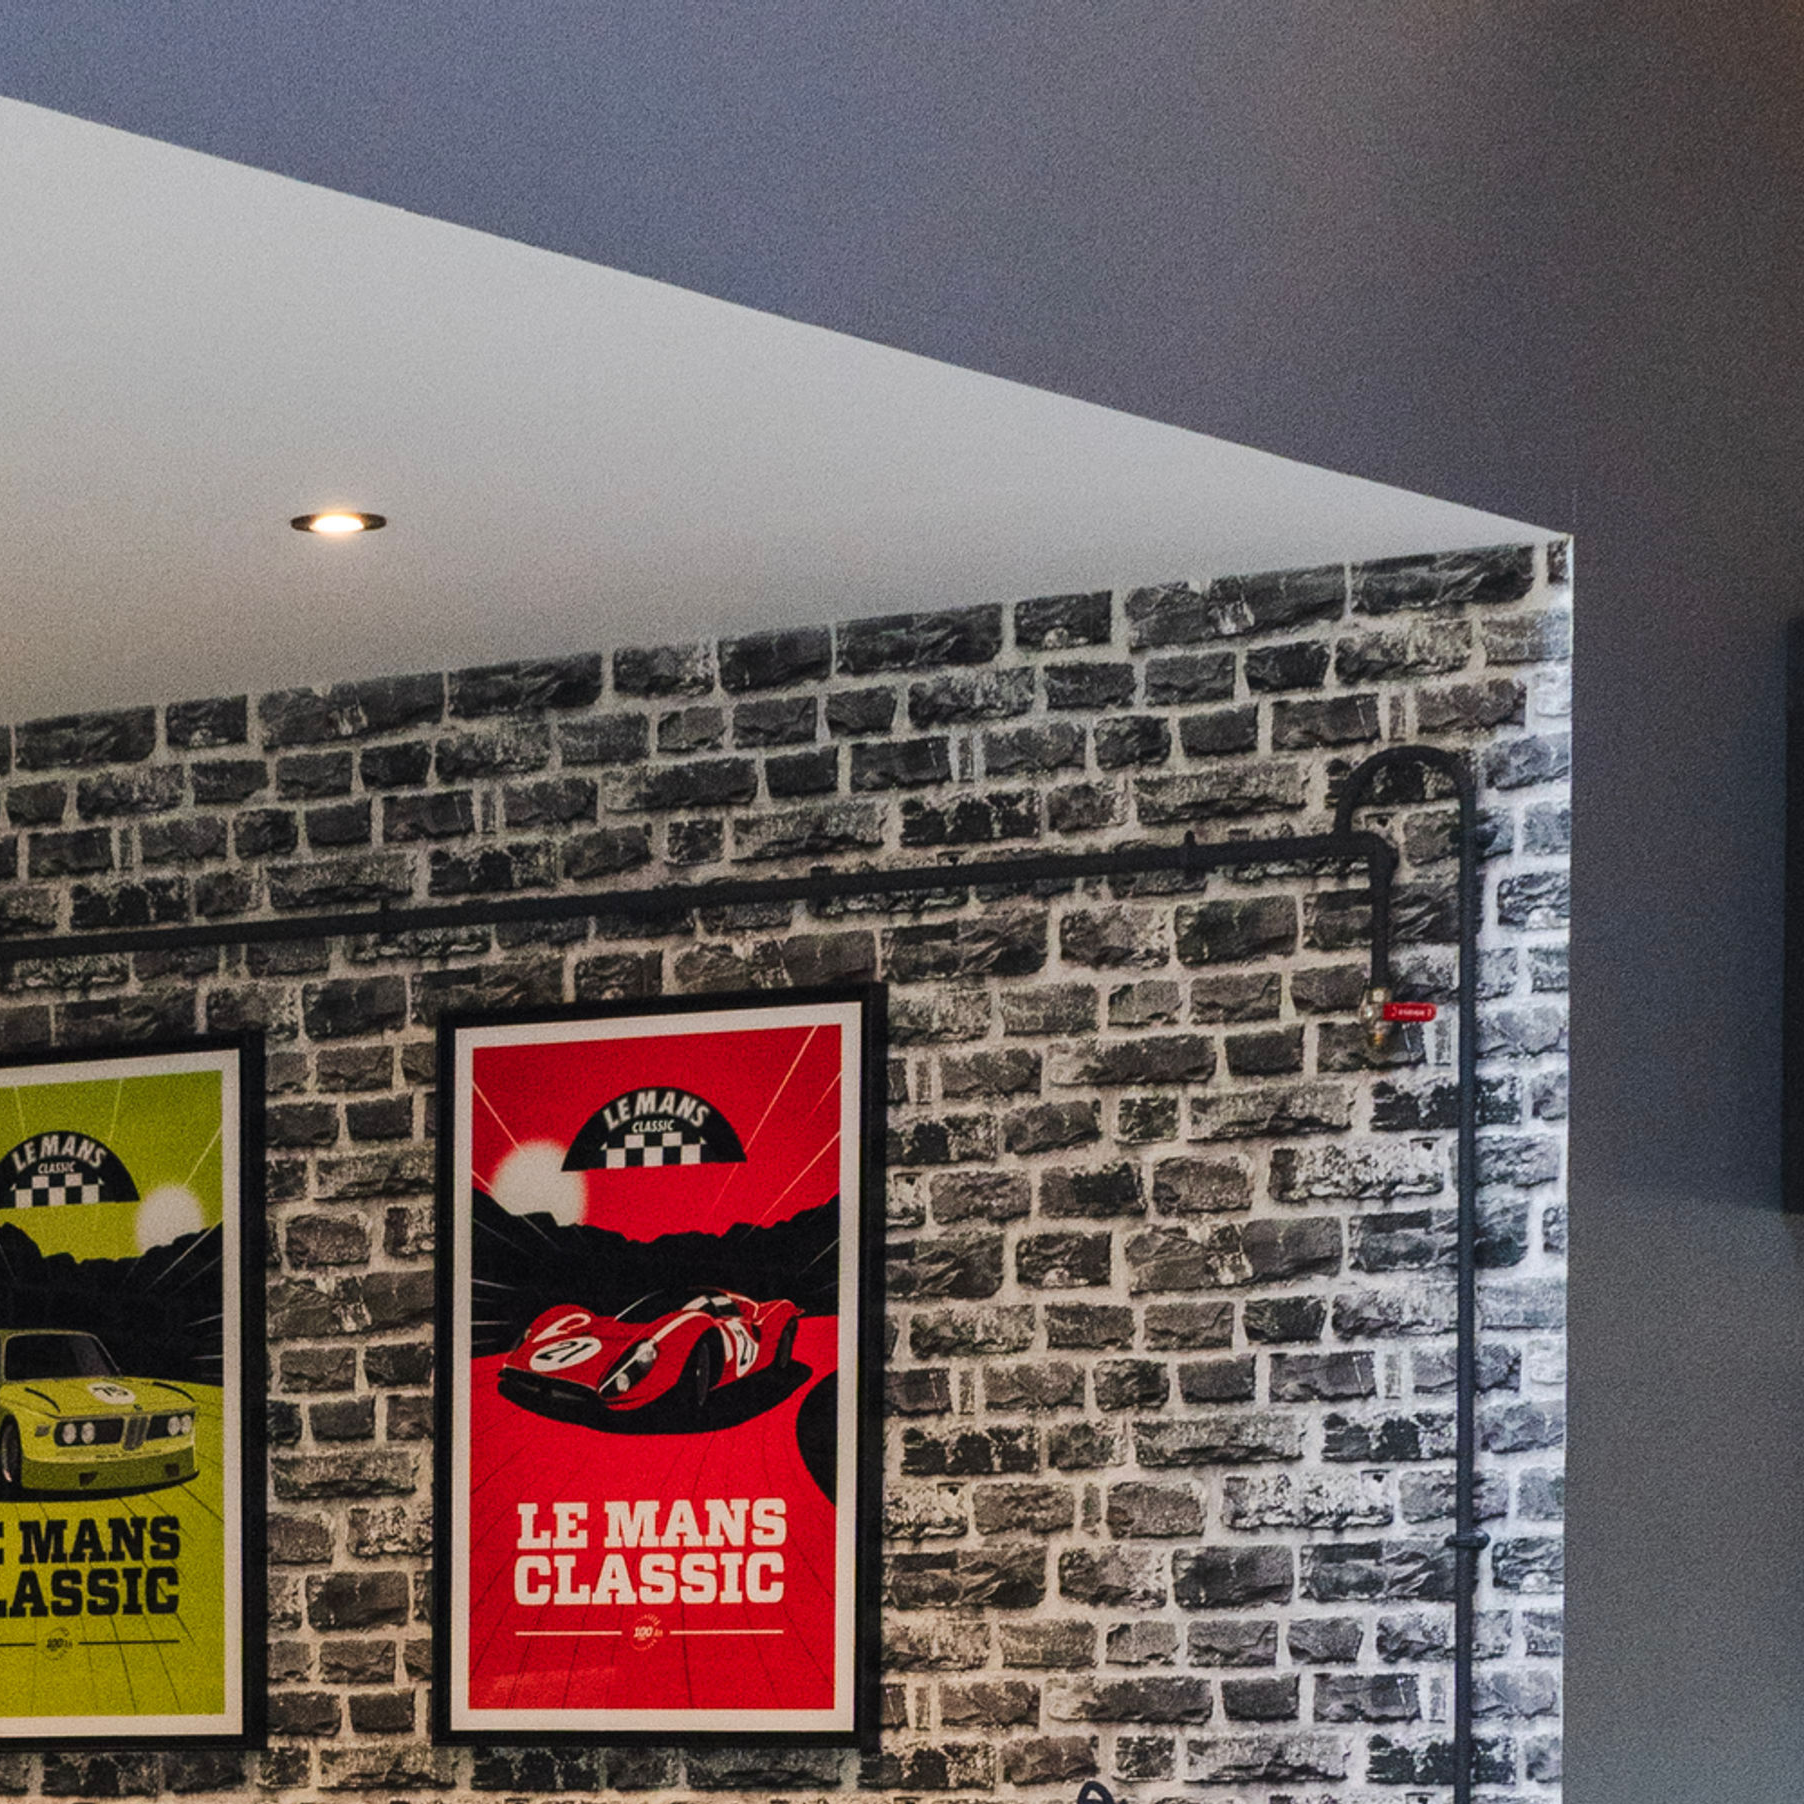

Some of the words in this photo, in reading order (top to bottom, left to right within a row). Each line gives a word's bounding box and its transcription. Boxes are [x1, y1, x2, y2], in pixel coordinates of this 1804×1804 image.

[602, 1096, 632, 1132] LE
[634, 1090, 710, 1128] MANS
[631, 1120, 676, 1133] CLASSIC
[10, 1141, 37, 1172] LE
[39, 1134, 108, 1168] MANS
[37, 1161, 77, 1174] CLASSIC
[535, 1340, 593, 1363] 21
[18, 1516, 181, 1565] MANS
[516, 1502, 589, 1550] LE
[603, 1498, 788, 1548] MANS
[514, 1552, 785, 1606] CLASSIC
